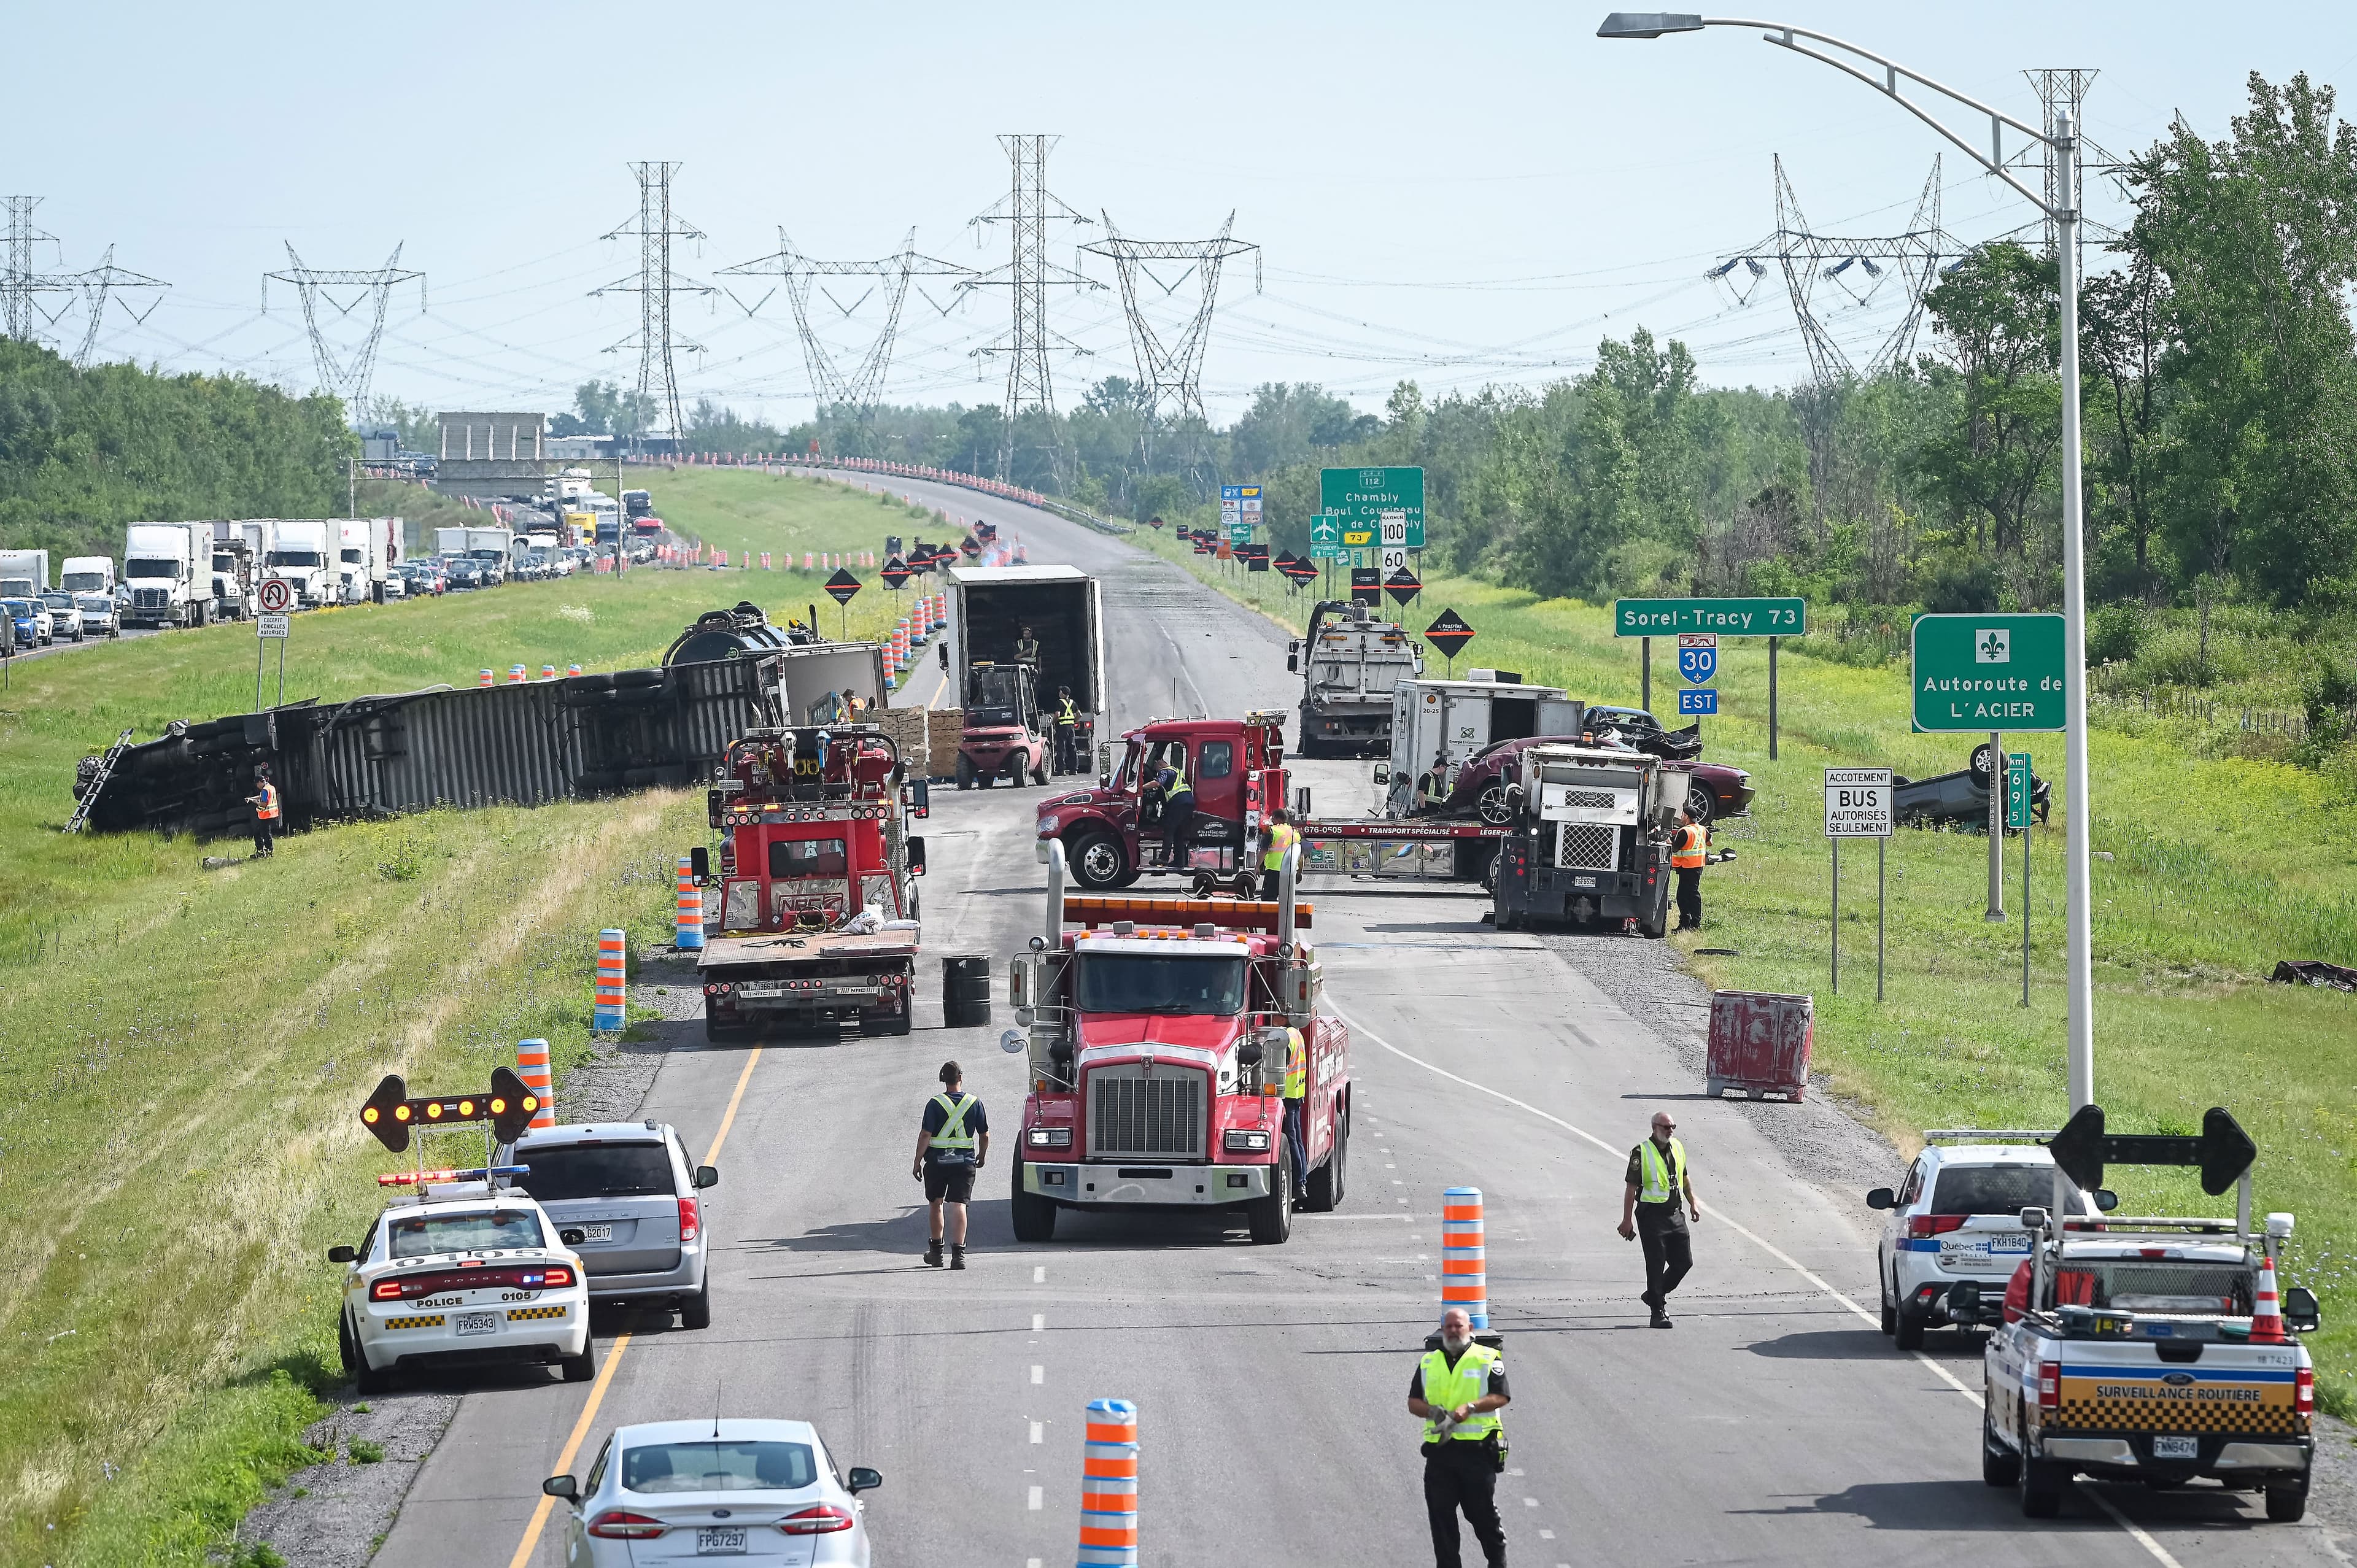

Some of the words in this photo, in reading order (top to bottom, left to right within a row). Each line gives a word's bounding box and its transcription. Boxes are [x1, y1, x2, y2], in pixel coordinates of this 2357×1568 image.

[1345, 493, 1399, 503] Chambly
[1384, 523, 1404, 539] 100
[1385, 552, 1403, 567] 60
[1624, 609, 1752, 629] Sorel-Tracy
[1768, 609, 1796, 624] 73
[1684, 652, 1712, 671] 30
[1924, 676, 2029, 692] Autoroute
[2040, 676, 2063, 691] de
[1682, 695, 1713, 709] EST
[1829, 773, 1887, 782] ACCOTEMENT
[1840, 790, 1877, 807] BUS
[1831, 808, 1887, 821] AUTORISÉS
[1829, 823, 1888, 832] SEULEMENT
[1941, 1242, 1975, 1251] Québec
[1992, 1237, 2026, 1247] FKH1840
[417, 1297, 463, 1307] POLICE
[501, 1292, 531, 1300] 0105
[459, 1319, 493, 1330] FRW5343
[2097, 1386, 2194, 1399] SURVEILLANCE
[2197, 1387, 2260, 1400] ROUTIÈRE
[699, 1534, 744, 1547] FPG7297
